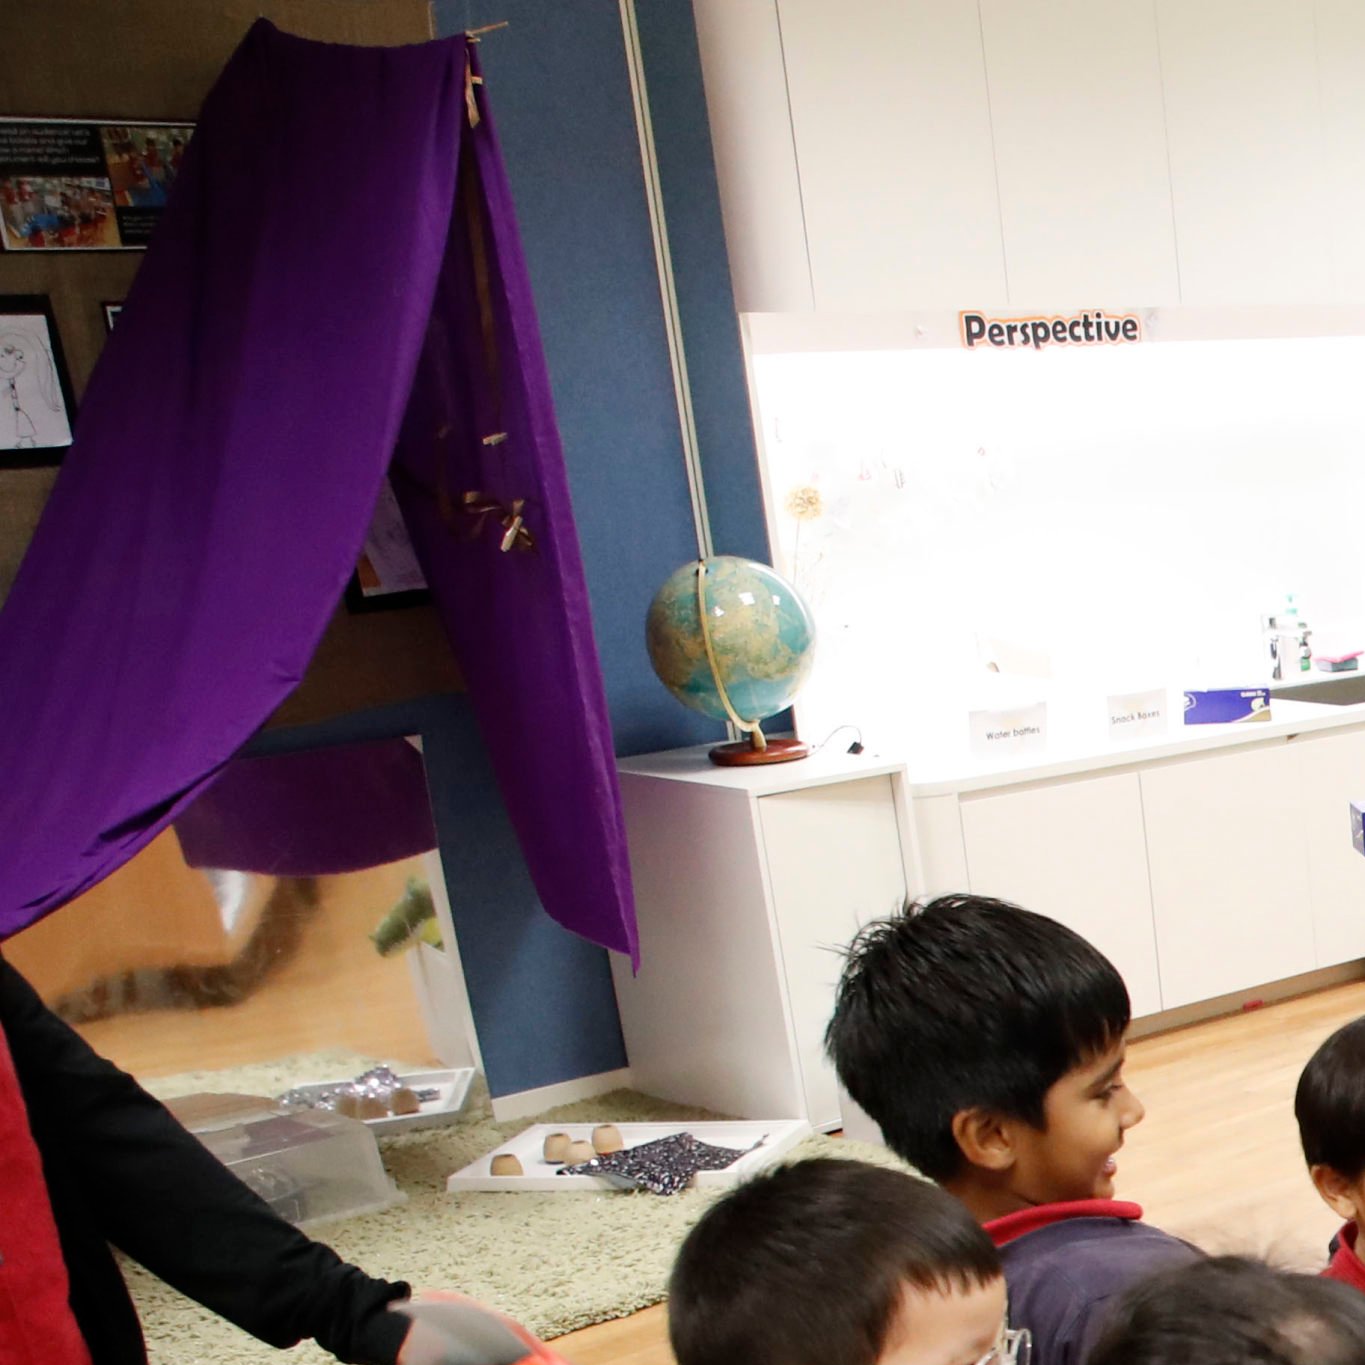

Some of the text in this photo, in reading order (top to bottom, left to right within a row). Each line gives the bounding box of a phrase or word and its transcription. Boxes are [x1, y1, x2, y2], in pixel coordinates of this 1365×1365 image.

[964, 311, 1138, 349] Perspective
[986, 725, 1041, 741] Water bottles
